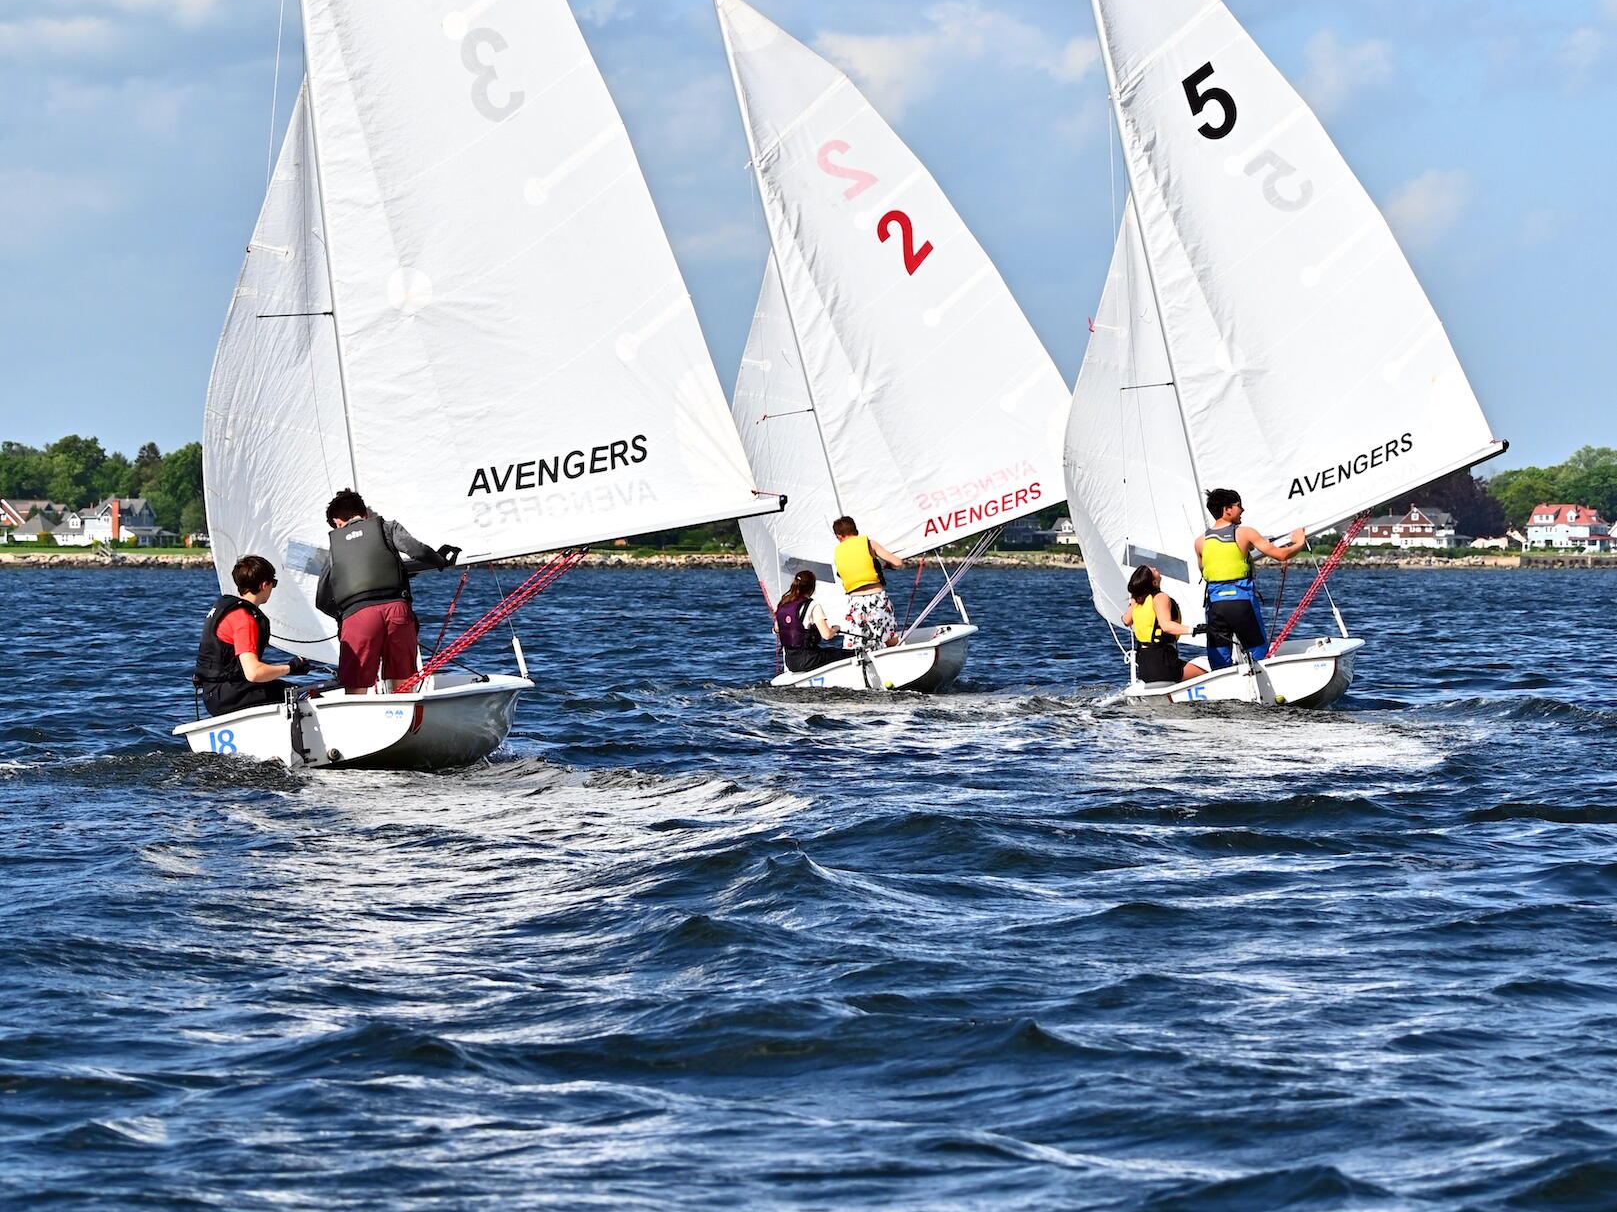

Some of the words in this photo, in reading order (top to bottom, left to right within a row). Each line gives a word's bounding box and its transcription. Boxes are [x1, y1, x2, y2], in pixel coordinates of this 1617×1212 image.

[1182, 61, 1237, 140] 5
[877, 210, 934, 276] 2
[467, 434, 648, 497] AVENGERS
[1287, 432, 1413, 500] AVENGERS
[924, 482, 1042, 537] AVENGERS
[1187, 686, 1208, 700] 15
[209, 729, 237, 754] 18
